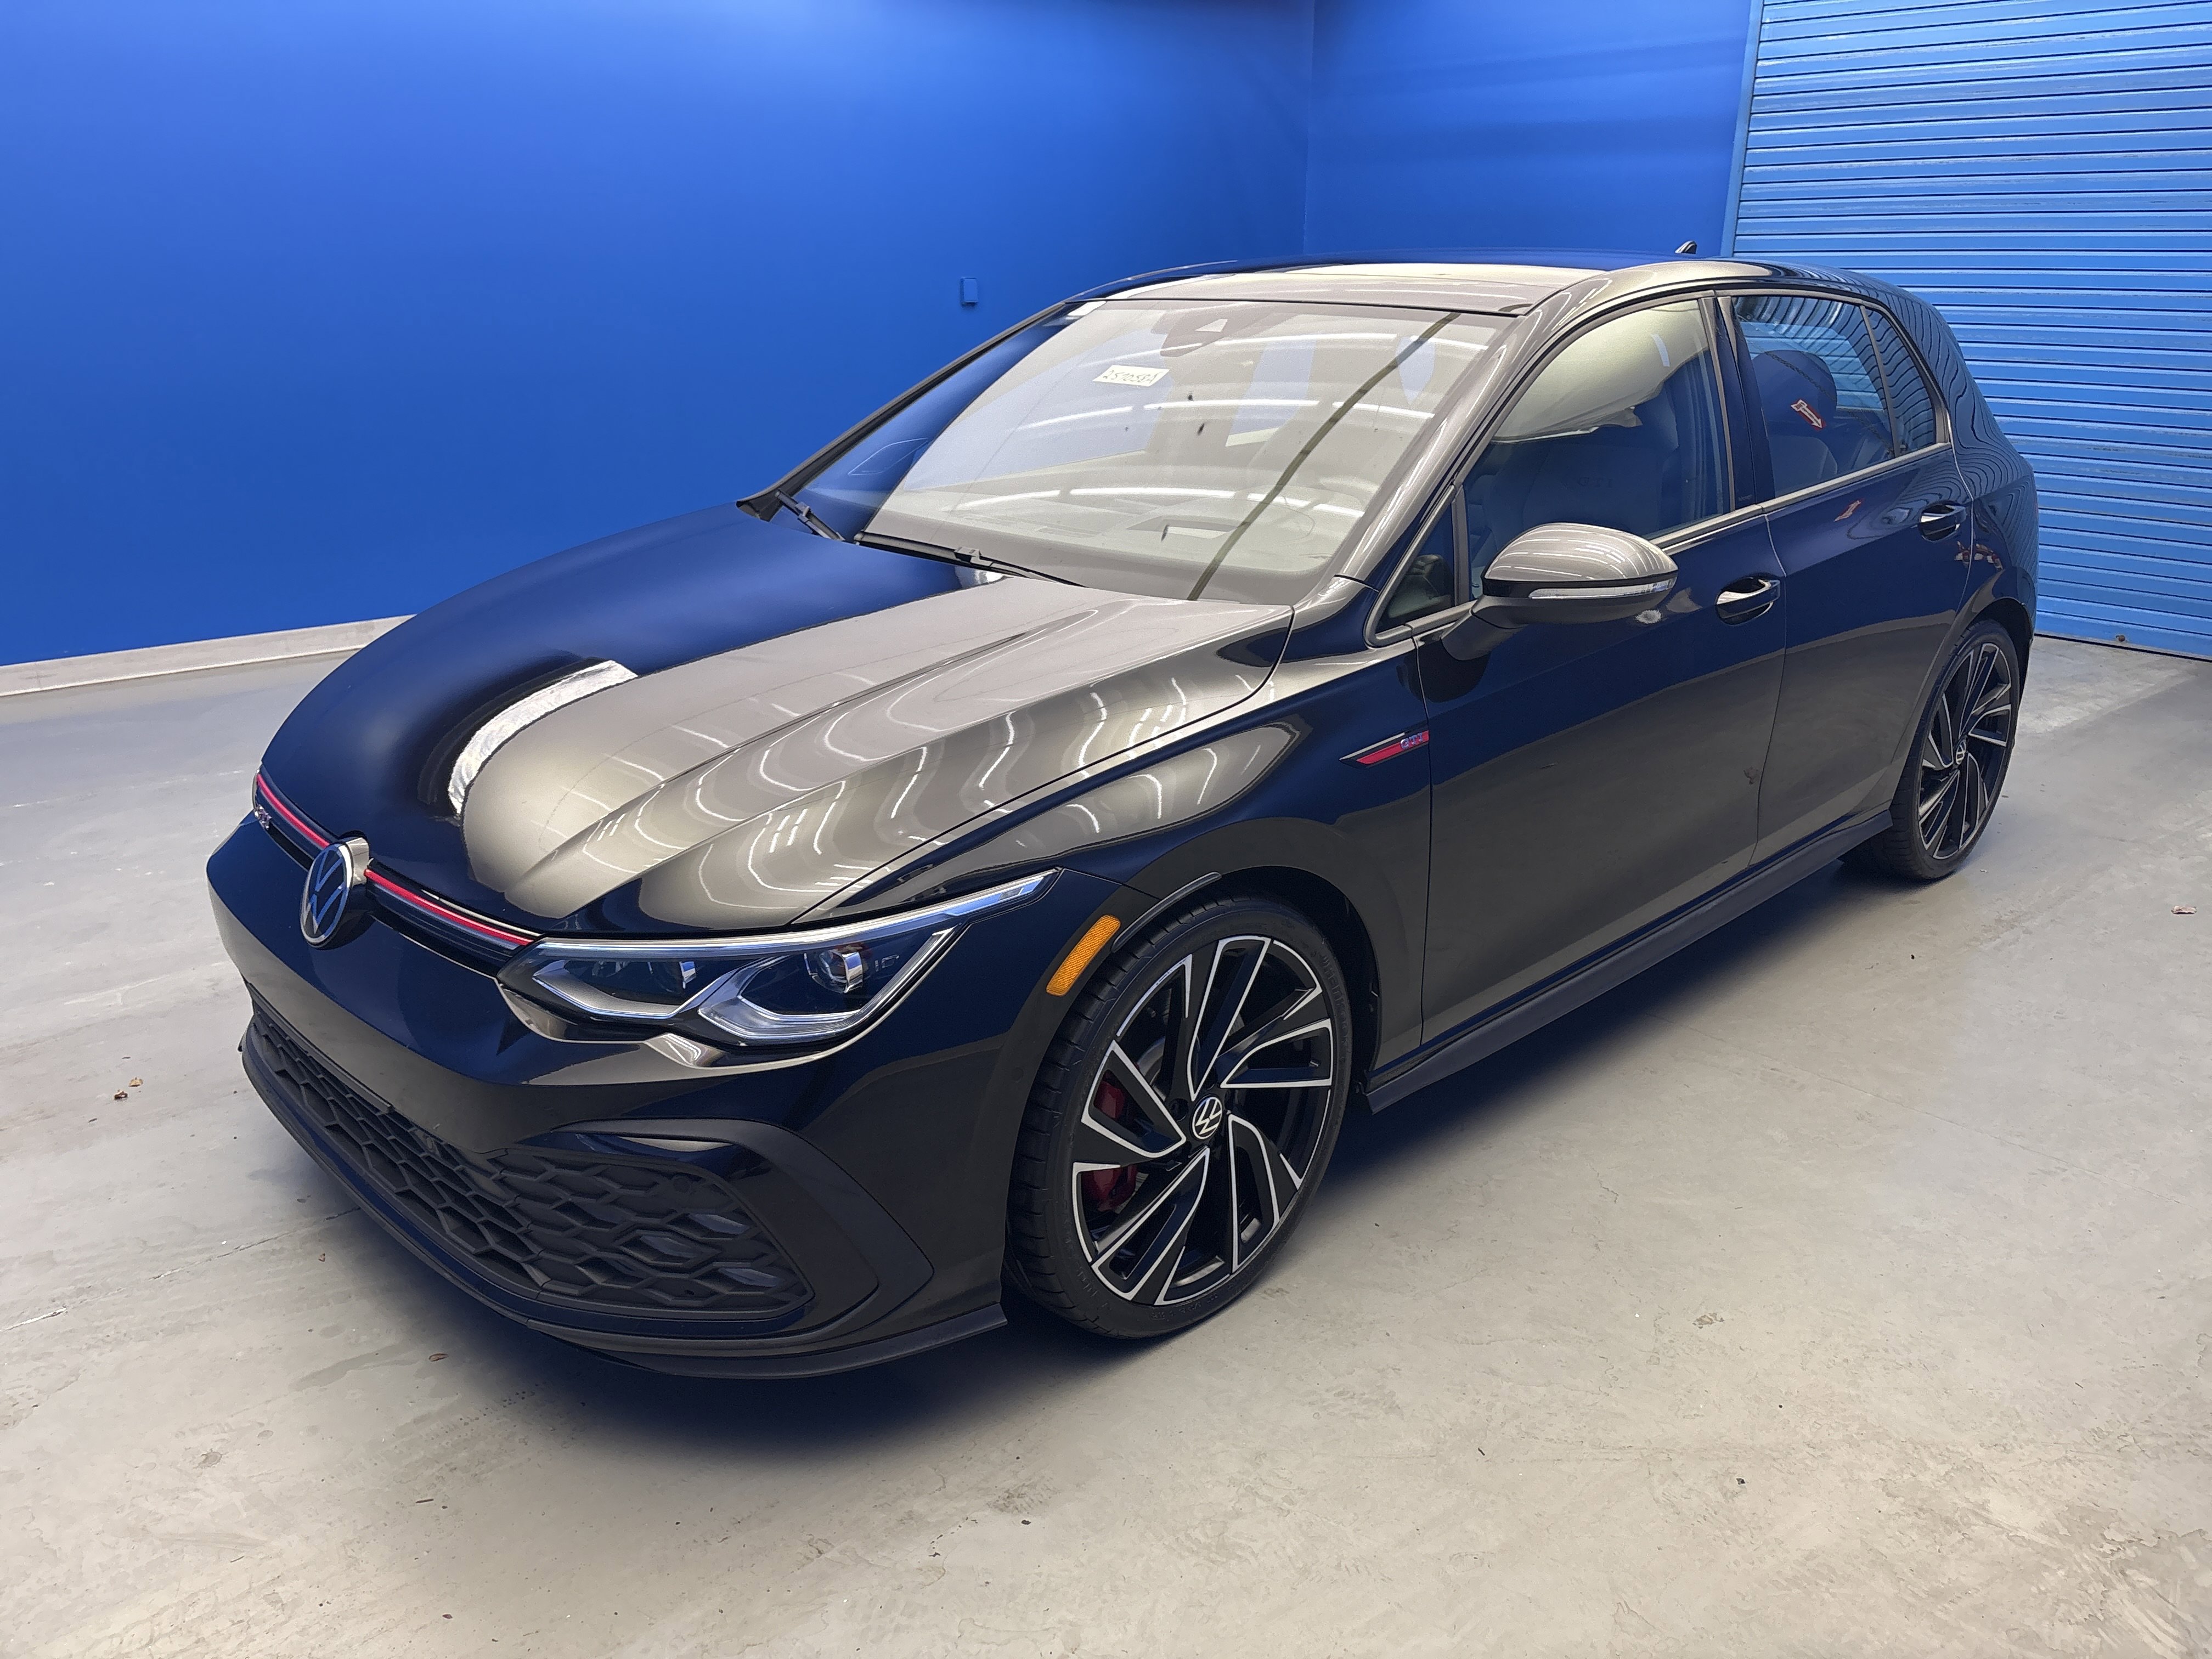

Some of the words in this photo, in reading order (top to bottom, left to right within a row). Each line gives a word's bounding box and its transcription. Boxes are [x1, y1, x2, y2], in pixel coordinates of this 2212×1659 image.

[1401, 732, 1423, 750] GTI
[302, 846, 349, 937] VW
[1193, 1097, 1222, 1137] VW
